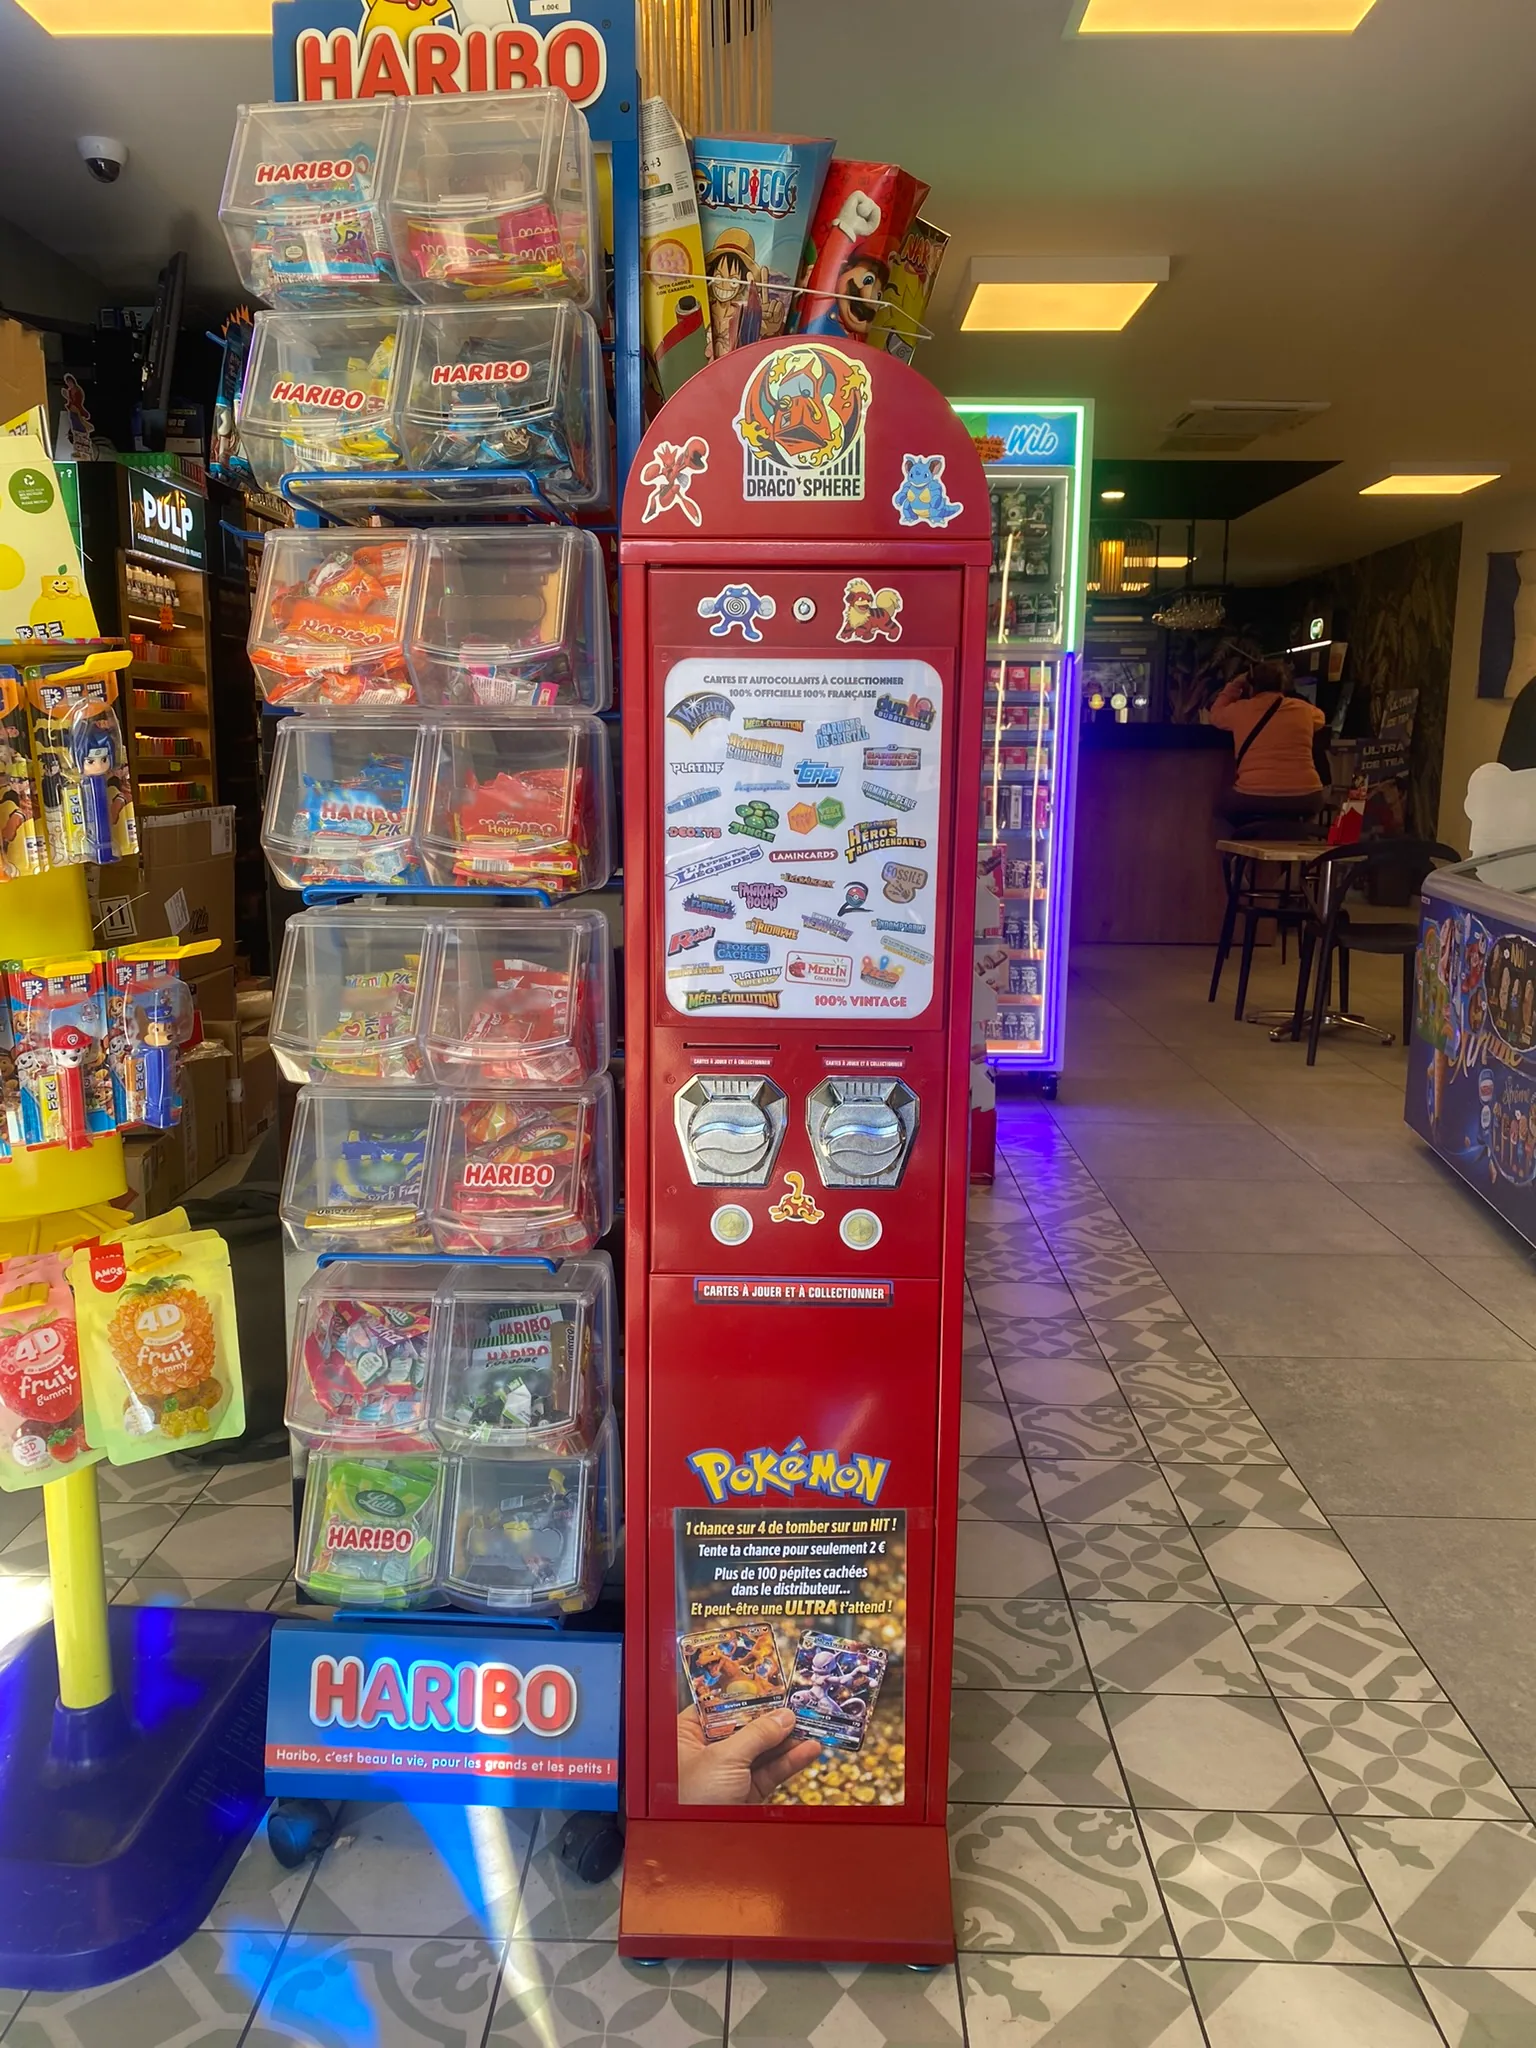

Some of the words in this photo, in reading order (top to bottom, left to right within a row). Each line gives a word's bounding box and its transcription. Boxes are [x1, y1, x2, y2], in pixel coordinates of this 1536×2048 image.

[299, 22, 605, 105] HARIBO
[255, 160, 354, 185] HARIBO
[432, 360, 530, 386] HARIBO
[271, 381, 366, 412] HARIBO
[143, 488, 193, 542] PULP
[15, 621, 63, 639] PEZ
[703, 675, 736, 685] CARTES
[738, 676, 749, 685] ET
[750, 675, 820, 685] AUTOCOLLANTS
[821, 673, 829, 685] À
[830, 676, 904, 686] COLLECTIONNER
[40, 680, 107, 709] PEZ
[729, 688, 752, 698] 100%
[754, 688, 802, 698] OFFICIELLE
[803, 689, 826, 699] 100%
[827, 690, 877, 701] FRANÇAISE
[675, 698, 730, 723] Wizards
[1362, 743, 1404, 756] ULTRA
[671, 762, 724, 774] PLATINE
[1385, 757, 1404, 766] TEA
[728, 821, 776, 843] JUNGLE
[773, 851, 835, 860] LAMINCARDS
[846, 837, 926, 863] TRANSCENDANTS
[886, 864, 923, 886] FOSSILE
[753, 917, 799, 940] TRIOMPHE
[726, 943, 766, 952] FORCES
[116, 960, 168, 986] PEZ
[730, 967, 782, 981] PLATINUM
[808, 963, 847, 977] MERLIN
[21, 974, 87, 1000] PEZ
[688, 990, 778, 1009] MÉGA-ÉVOLUTION
[815, 995, 847, 1007] 100%
[850, 996, 907, 1008] VINTAGE
[45, 1081, 58, 1110] PEZ
[465, 1164, 553, 1186] HARIBO
[94, 1266, 124, 1280] AMOS
[703, 1285, 739, 1297] CARTES
[742, 1282, 750, 1297] À
[752, 1285, 781, 1298] JOUER
[785, 1286, 796, 1298] ET
[799, 1284, 806, 1298] À
[808, 1286, 884, 1299] COLLECTIONNER
[137, 1304, 180, 1332] 4D
[498, 1316, 552, 1336] HARIBO
[15, 1328, 60, 1362] 4D
[137, 1340, 193, 1366] fruit
[152, 1361, 188, 1377] gummy
[19, 1364, 77, 1399] fruit
[36, 1384, 73, 1406] gummy
[686, 1522, 691, 1535] 1
[693, 1522, 734, 1535] chance
[736, 1524, 756, 1535] sur
[758, 1521, 766, 1534] 4
[768, 1520, 783, 1534] de
[785, 1520, 830, 1534] tomber
[831, 1522, 851, 1533] sur
[852, 1522, 867, 1532] un
[870, 1518, 891, 1532] HIT
[891, 1518, 897, 1531] !
[327, 1526, 412, 1551] HARIBO
[699, 1544, 727, 1557] Tente
[730, 1545, 741, 1556] ta
[743, 1543, 781, 1556] chance
[783, 1546, 809, 1559] pour
[810, 1542, 868, 1555] seulement
[869, 1542, 876, 1554] 2
[878, 1541, 886, 1554] €
[715, 1567, 738, 1581] Plus
[740, 1567, 755, 1580] de
[757, 1567, 778, 1580] 100
[780, 1566, 822, 1582] pépites
[823, 1564, 868, 1579] cachées
[731, 1583, 759, 1596] dans
[761, 1583, 772, 1596] le
[773, 1582, 851, 1596] distributeur...
[691, 1602, 702, 1615] Et
[704, 1601, 759, 1617] peut-être
[761, 1604, 782, 1615] une
[785, 1600, 837, 1615] ULTRA
[839, 1600, 886, 1615] t'attend
[886, 1600, 893, 1613] !
[311, 1656, 576, 1736] HARIBO
[276, 1749, 321, 1764] Haribo,
[325, 1749, 353, 1763] c'est
[356, 1750, 388, 1765] beau
[391, 1752, 403, 1766] la
[406, 1753, 428, 1769] vie,
[432, 1757, 461, 1771] pour
[464, 1755, 481, 1769] les
[484, 1755, 527, 1775] grands
[531, 1759, 544, 1772] et
[547, 1760, 564, 1773] les
[568, 1761, 602, 1776] petits
[606, 1763, 612, 1775] !
